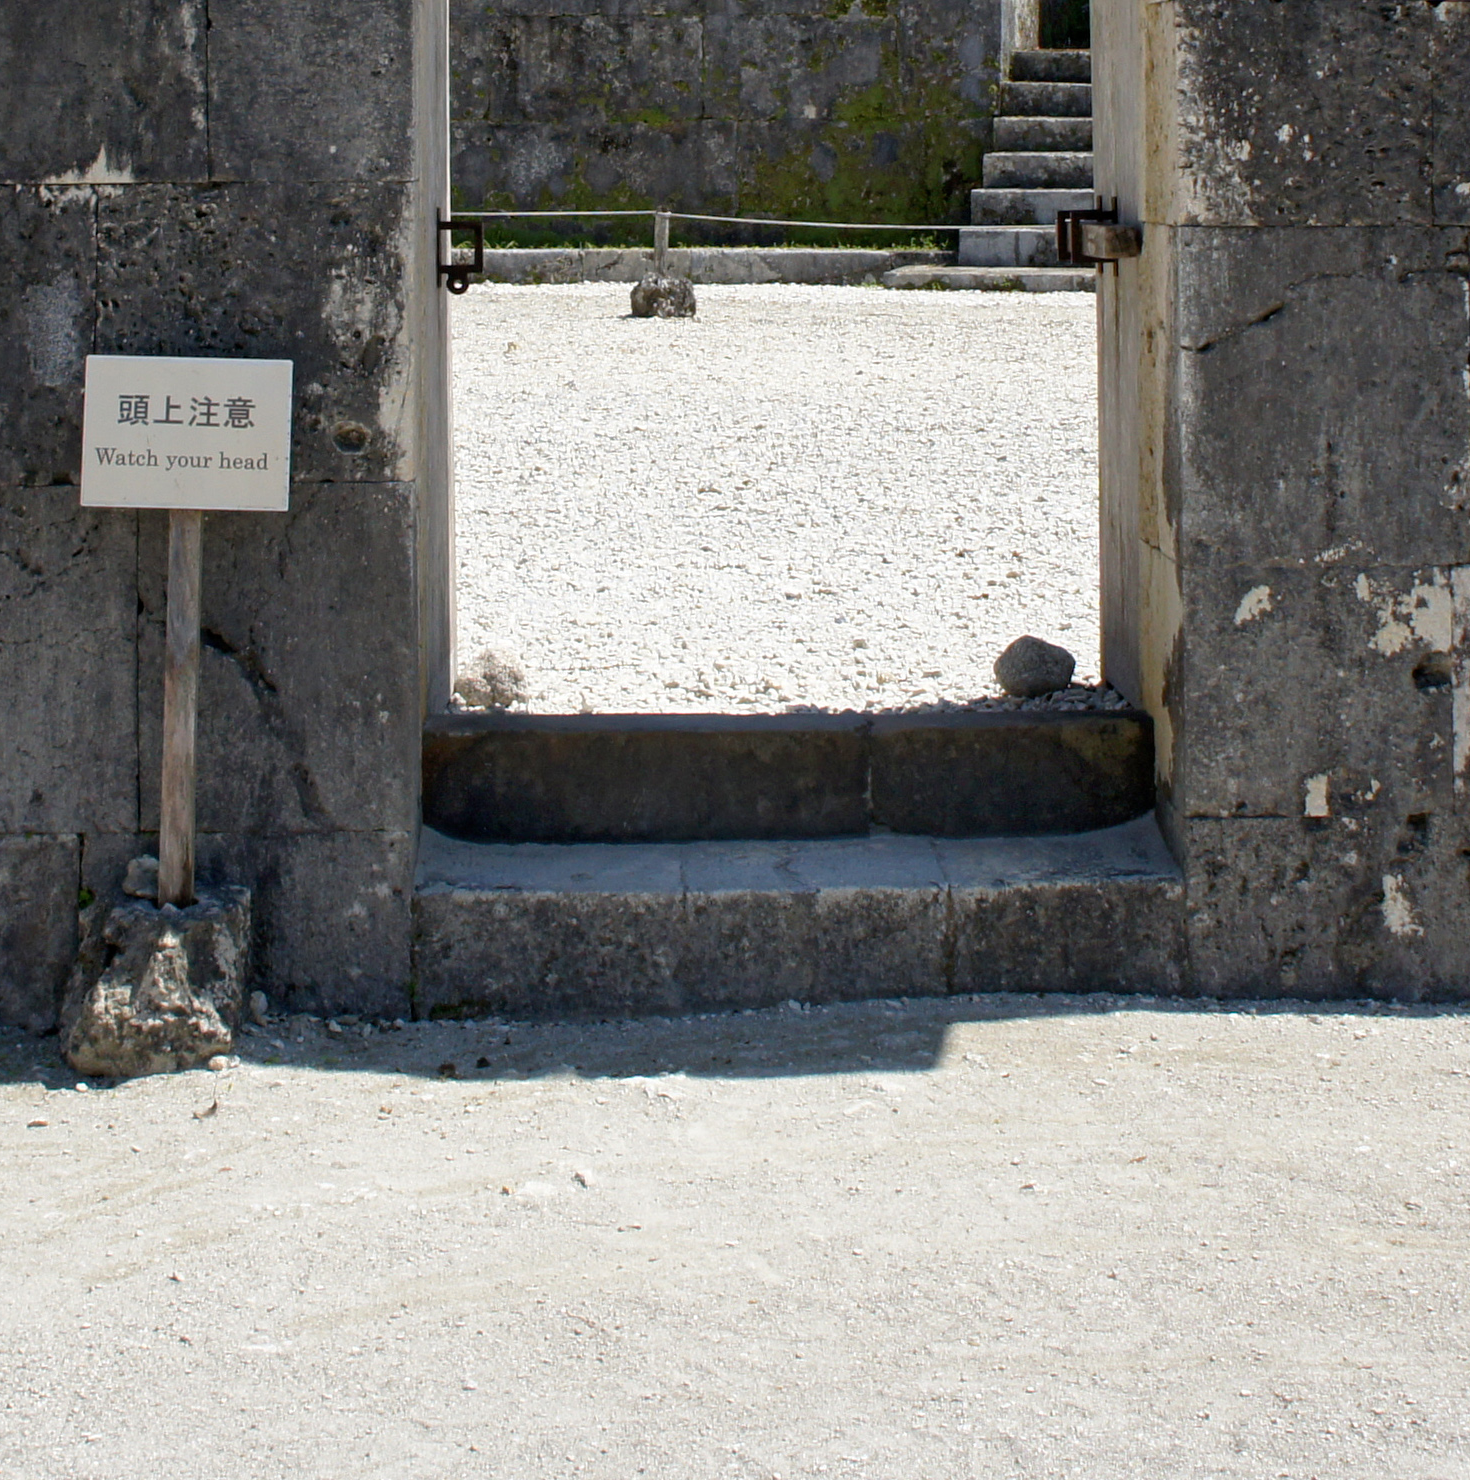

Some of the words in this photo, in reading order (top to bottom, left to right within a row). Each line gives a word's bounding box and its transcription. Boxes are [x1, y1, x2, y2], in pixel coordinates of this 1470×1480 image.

[117, 394, 256, 429] 頭上注意
[95, 446, 159, 467] Watch
[165, 454, 213, 471] your
[218, 451, 268, 471] head
